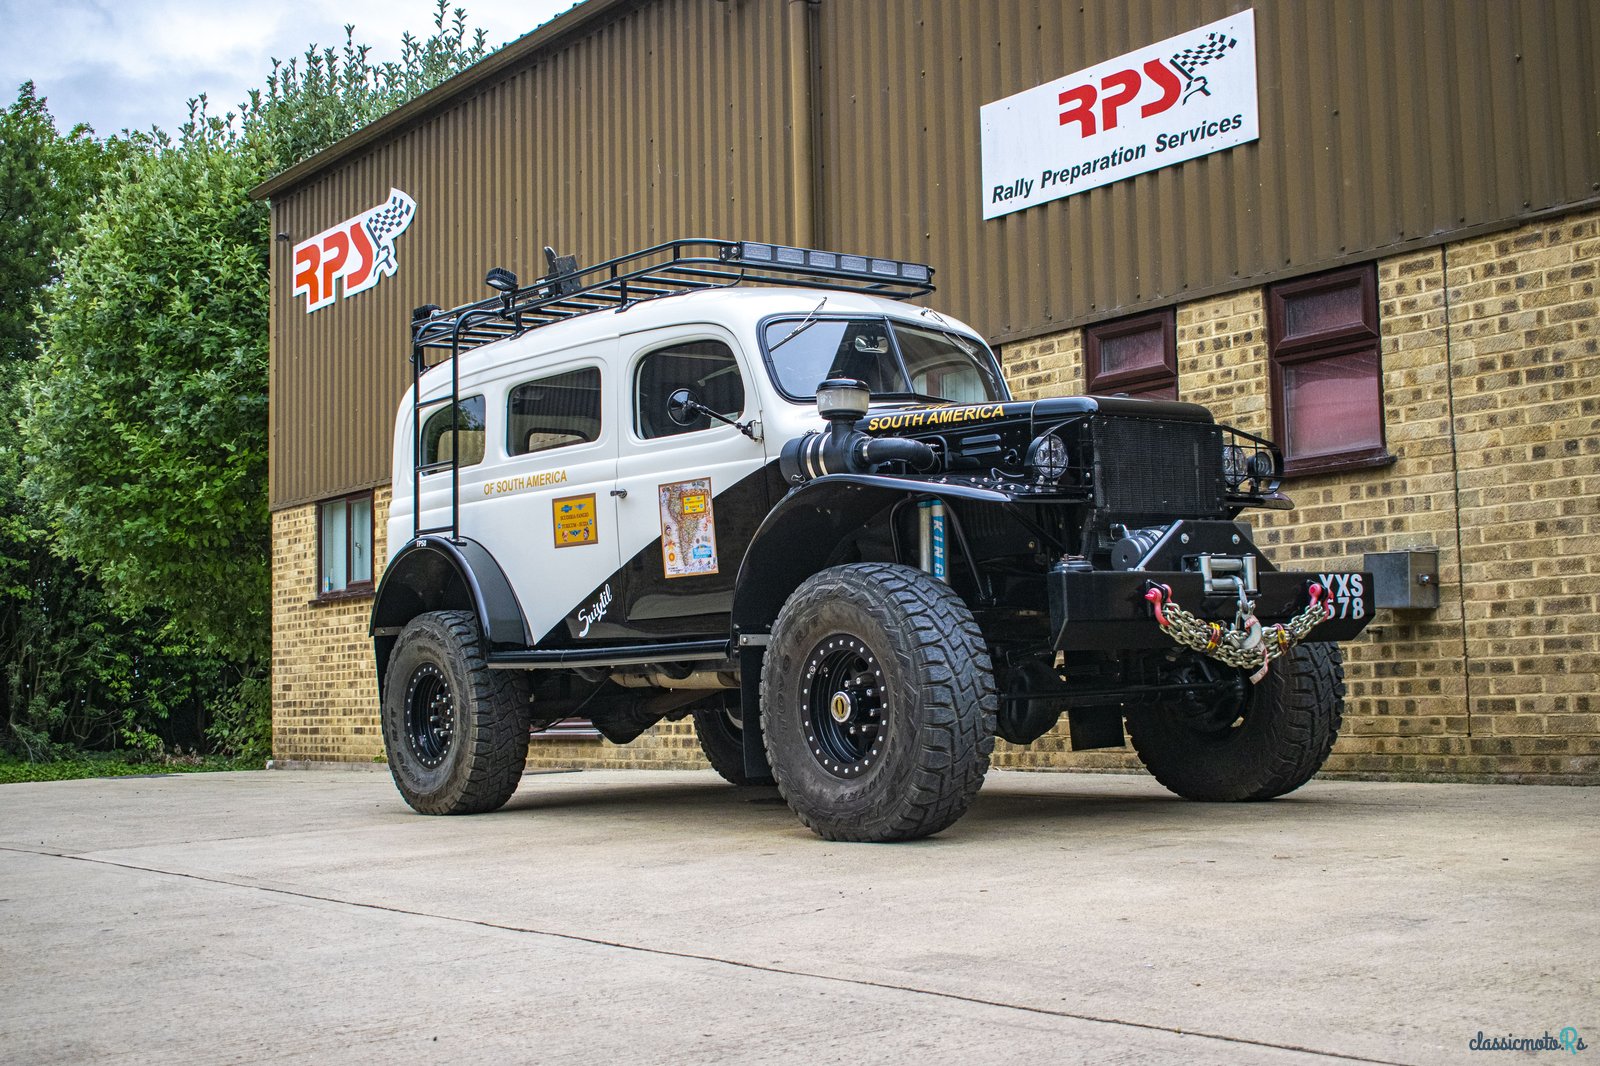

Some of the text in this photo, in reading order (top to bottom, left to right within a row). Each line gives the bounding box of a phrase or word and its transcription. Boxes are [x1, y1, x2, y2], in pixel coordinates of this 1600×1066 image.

[1058, 58, 1182, 139] RPS
[992, 113, 1243, 204] Rally Preparation Services
[296, 222, 373, 305] RPS
[868, 412, 925, 431] SOUTH
[927, 405, 1005, 425] AMERICA
[483, 469, 568, 496] OF SOUTH AMERICA
[933, 519, 944, 576] KING
